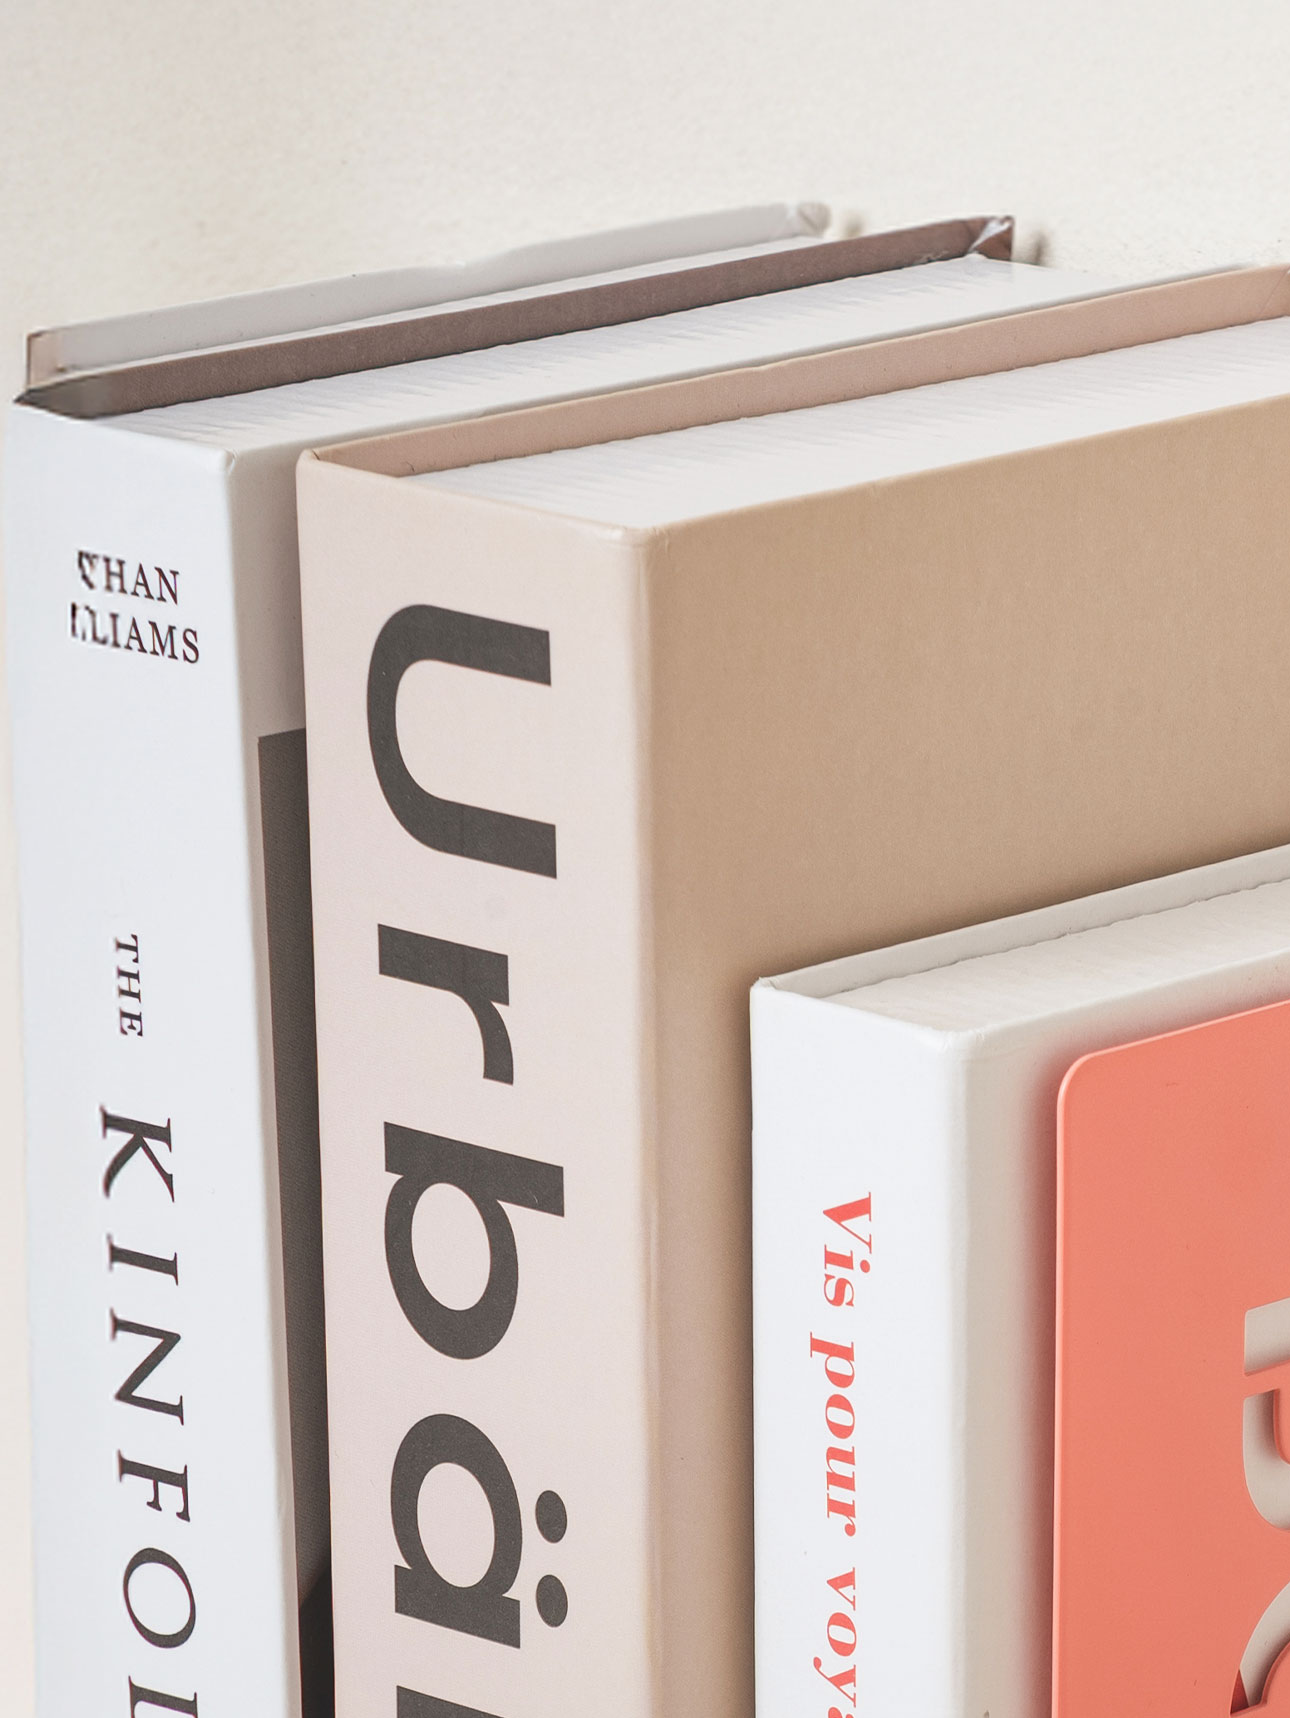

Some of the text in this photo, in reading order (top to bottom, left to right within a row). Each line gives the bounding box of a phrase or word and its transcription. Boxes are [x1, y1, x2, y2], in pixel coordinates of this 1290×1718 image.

[115, 934, 144, 1038] THE
[822, 1191, 873, 1307] Vis
[809, 1332, 857, 1538] pour
